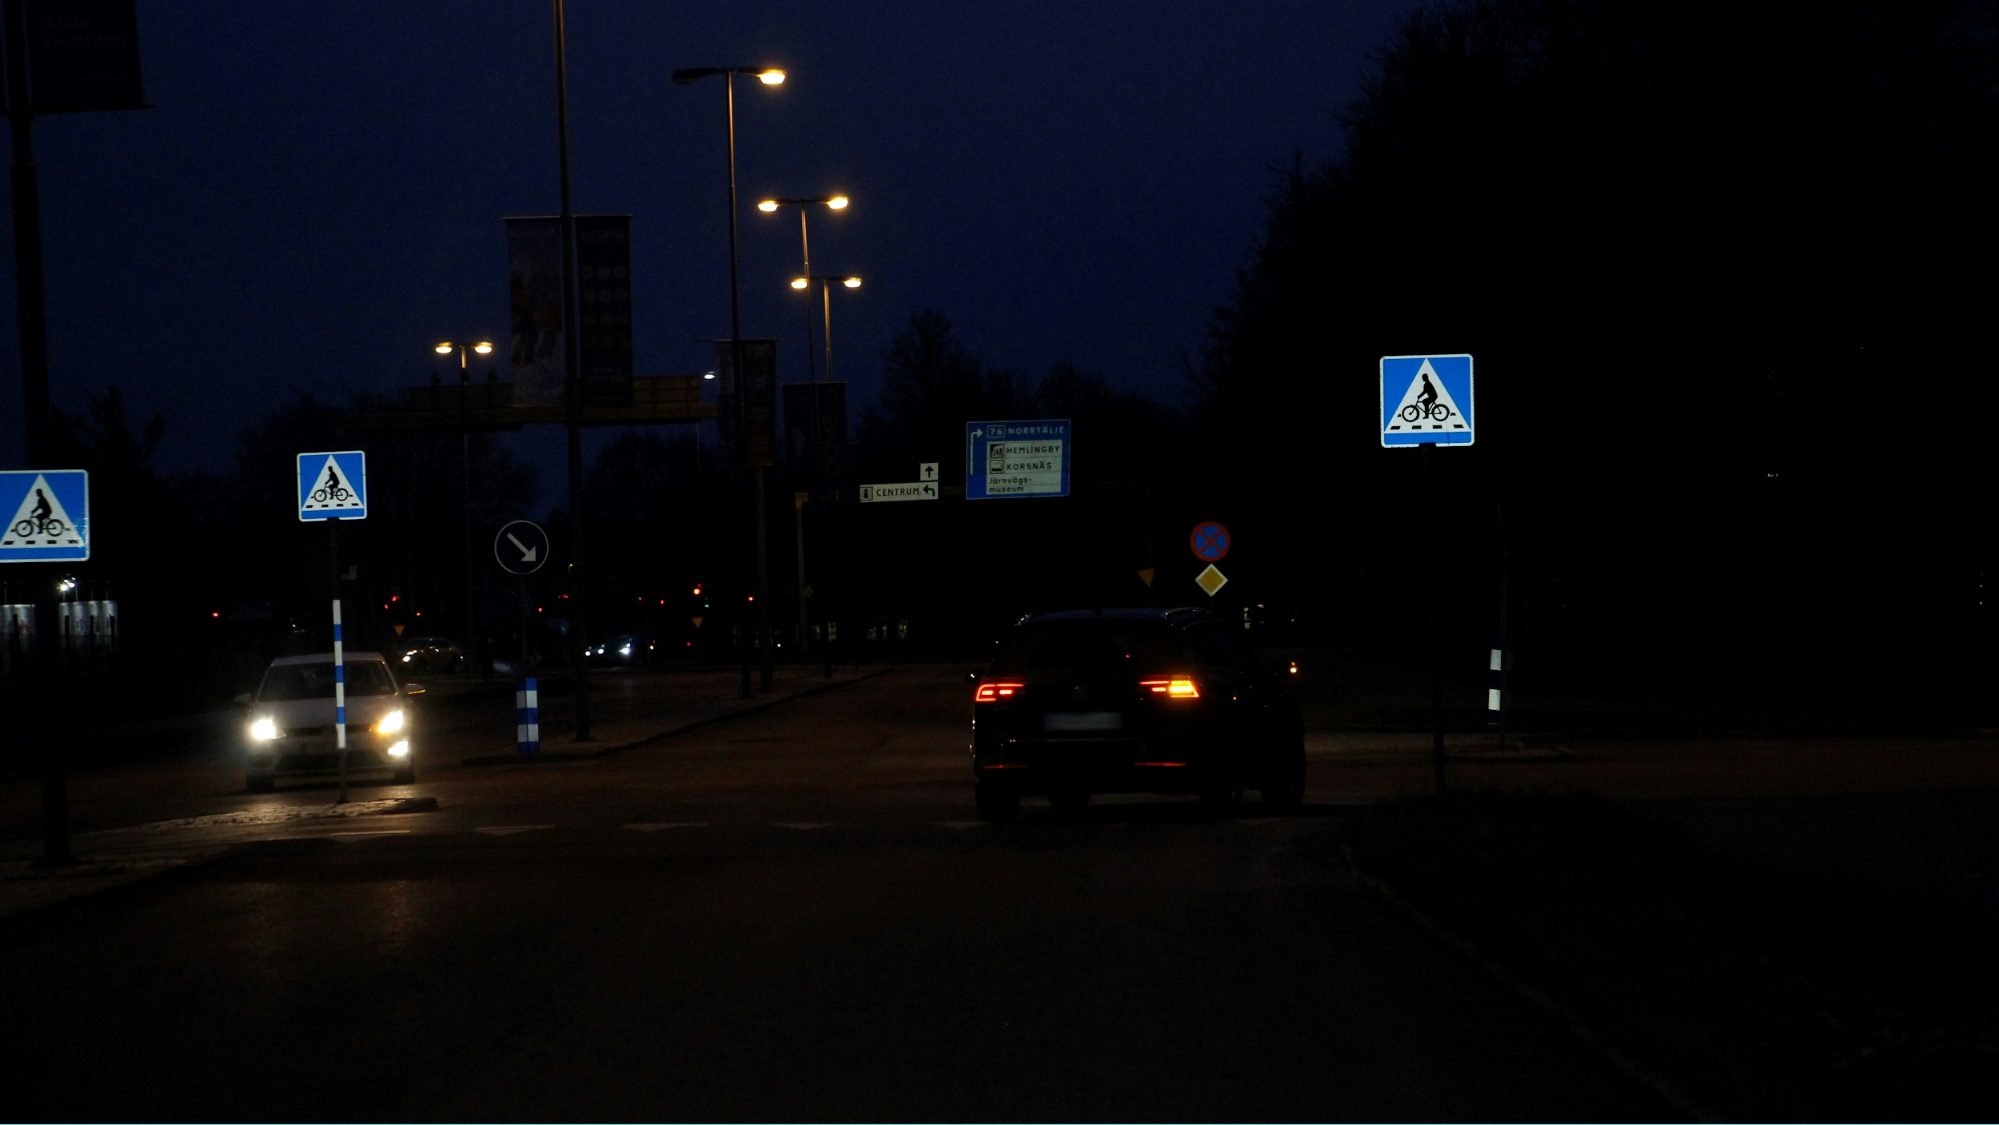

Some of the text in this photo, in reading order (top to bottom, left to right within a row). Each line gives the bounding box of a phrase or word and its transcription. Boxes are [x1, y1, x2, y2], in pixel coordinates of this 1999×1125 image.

[990, 428, 1003, 436] 76
[1006, 445, 1060, 454] HEMLINGBY
[1006, 461, 1052, 470] KORSNÄS
[876, 487, 920, 496] CENTRUM
